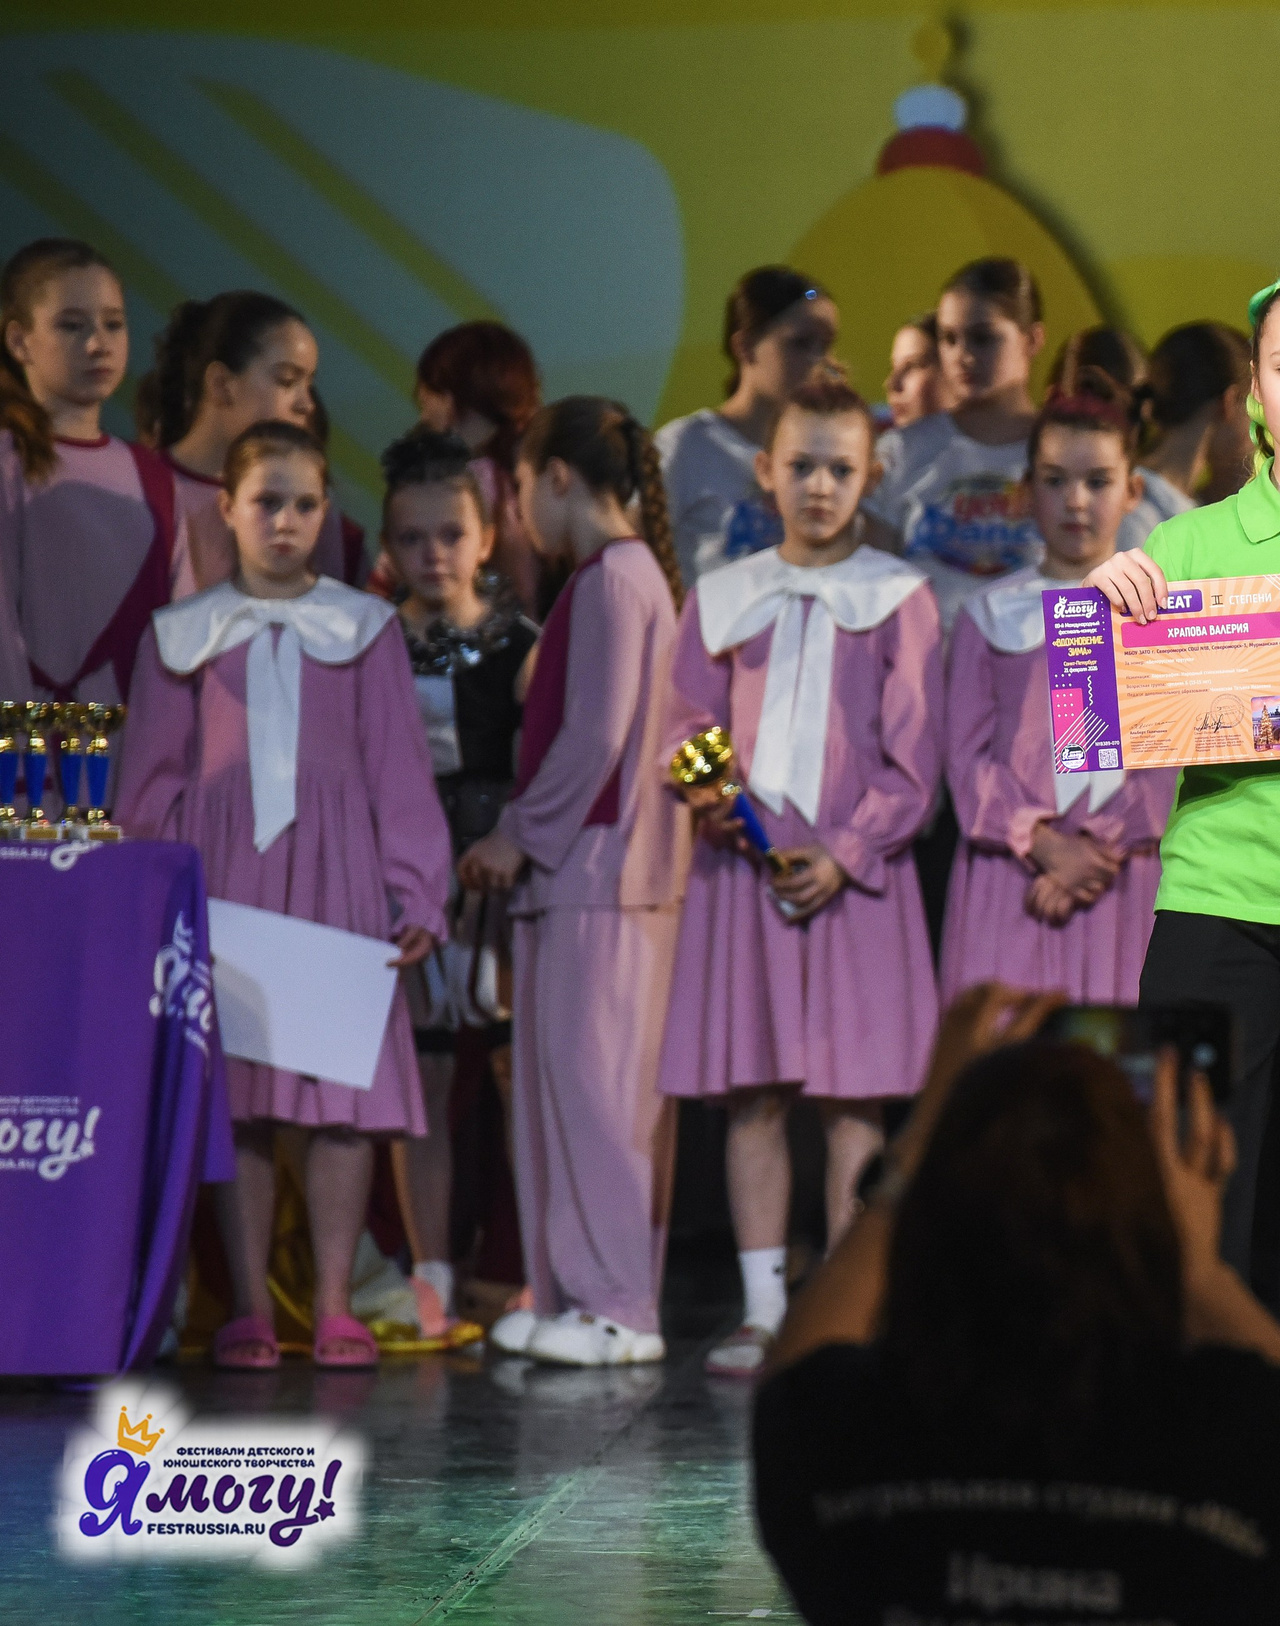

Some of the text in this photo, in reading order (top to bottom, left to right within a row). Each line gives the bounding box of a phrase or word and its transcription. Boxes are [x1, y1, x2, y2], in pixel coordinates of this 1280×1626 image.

[1229, 594, 1272, 606] СТЕПЕНИ
[1054, 602, 1098, 619] Я могу!
[1167, 622, 1249, 639] ХРАПОВА ВАЛЕРИЯ
[1068, 646, 1092, 657] ЗИМА»
